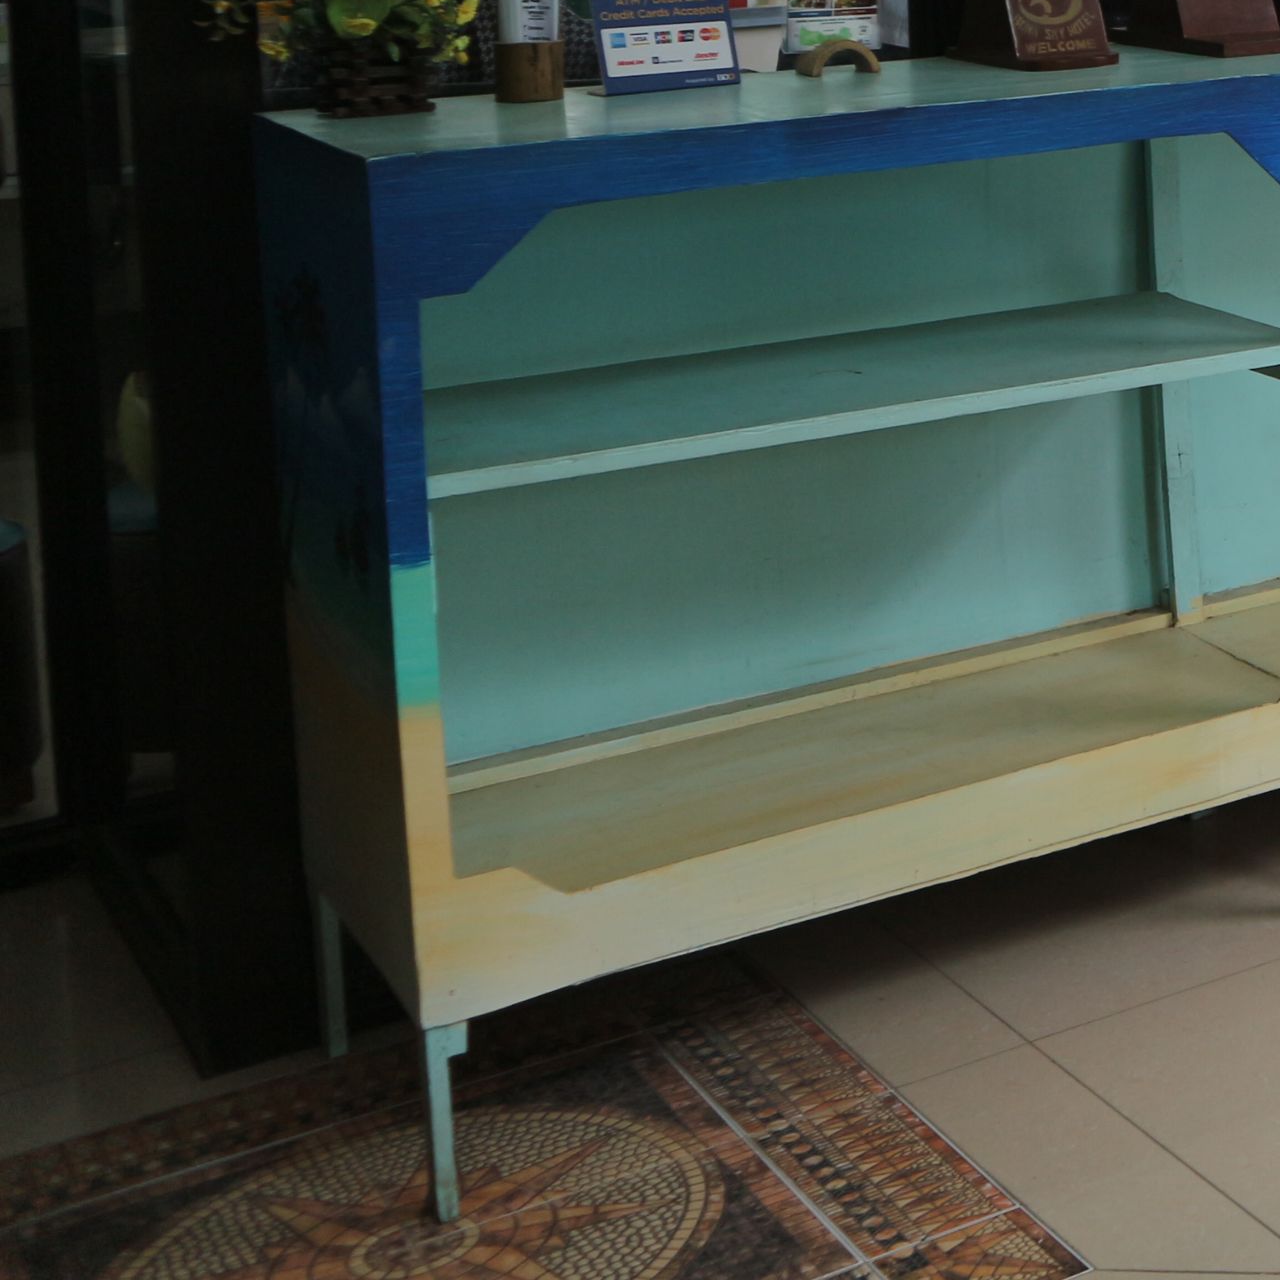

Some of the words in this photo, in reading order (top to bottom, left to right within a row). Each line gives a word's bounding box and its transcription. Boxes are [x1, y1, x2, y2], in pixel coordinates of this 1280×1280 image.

[600, 9, 635, 22] Credit
[638, 7, 670, 19] Cards
[672, 4, 725, 18] Accepted
[1025, 38, 1098, 55] WELCOME
